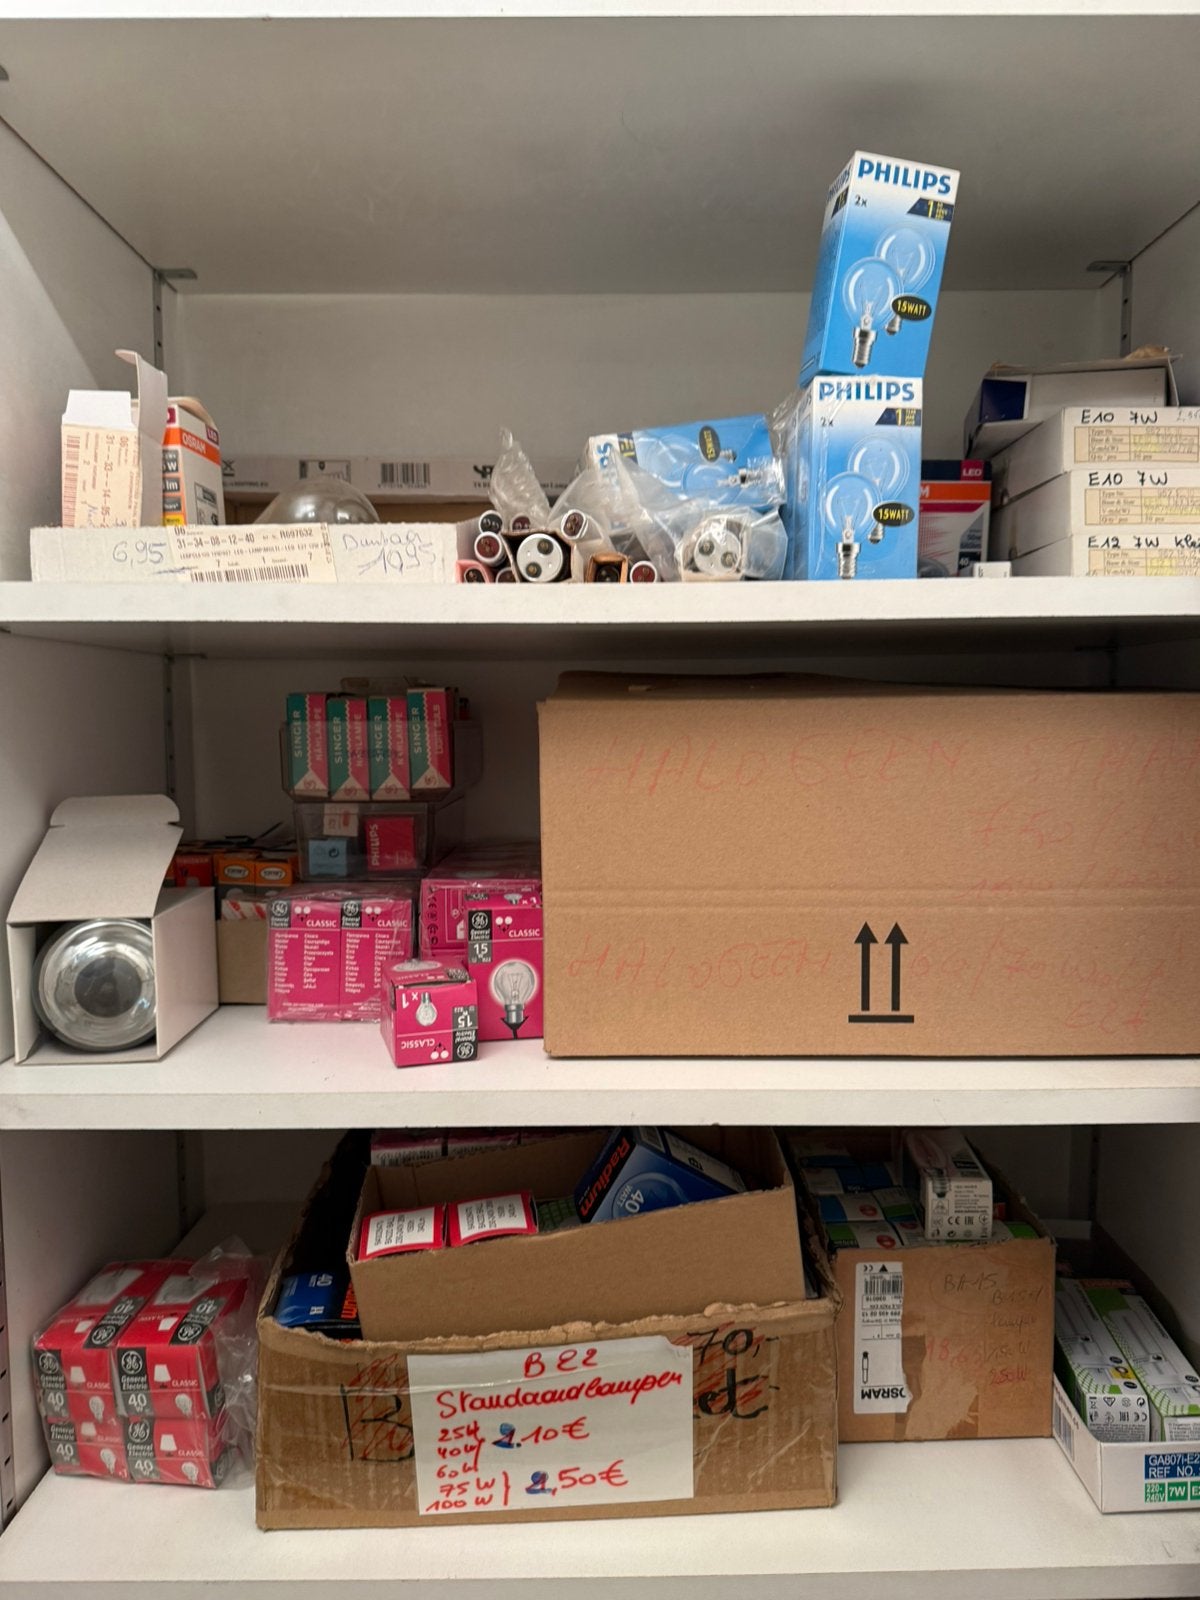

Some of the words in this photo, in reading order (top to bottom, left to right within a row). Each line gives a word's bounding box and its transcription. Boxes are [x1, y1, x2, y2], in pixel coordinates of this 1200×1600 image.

[858, 158, 951, 195] PHILIPS
[819, 382, 915, 401] PHILIPS
[1081, 409, 1115, 424] E10
[182, 432, 206, 455] OSRAM
[963, 468, 983, 476] LED
[1089, 472, 1123, 486] E10
[878, 508, 910, 521] 15WATT
[1088, 536, 1120, 549] E12
[293, 710, 303, 757] SINGER
[412, 707, 422, 754] SINGER
[333, 716, 343, 764] SINGER
[374, 715, 384, 762] SINGER
[369, 824, 380, 866] PHILIPS
[306, 919, 337, 928] CLASSIC
[377, 919, 408, 928] CLASSIC
[508, 929, 540, 938] CLASSIC
[473, 943, 488, 954] 15
[457, 1016, 473, 1028] 15
[401, 1038, 435, 1048] CLASSIC
[580, 1137, 630, 1217] Radium
[625, 1189, 645, 1213] 40
[113, 1302, 135, 1314] 40
[196, 1302, 217, 1314] 40
[40, 1375, 65, 1383] General
[121, 1375, 147, 1383] General
[172, 1379, 198, 1387] CLASSIC
[42, 1381, 66, 1390] Electric
[87, 1382, 111, 1390] CLASSIC
[122, 1382, 148, 1390] Electric
[47, 1392, 64, 1405] 40
[128, 1393, 147, 1406] 40
[51, 1424, 75, 1434] General
[51, 1432, 75, 1441] Electric
[56, 1443, 73, 1456] 40
[127, 1443, 153, 1451] General
[128, 1450, 154, 1458] Electric
[134, 1459, 153, 1472] 40
[1148, 1466, 1171, 1479] REF
[1176, 1465, 1195, 1477] NO.
[1169, 1486, 1185, 1497] 7W
